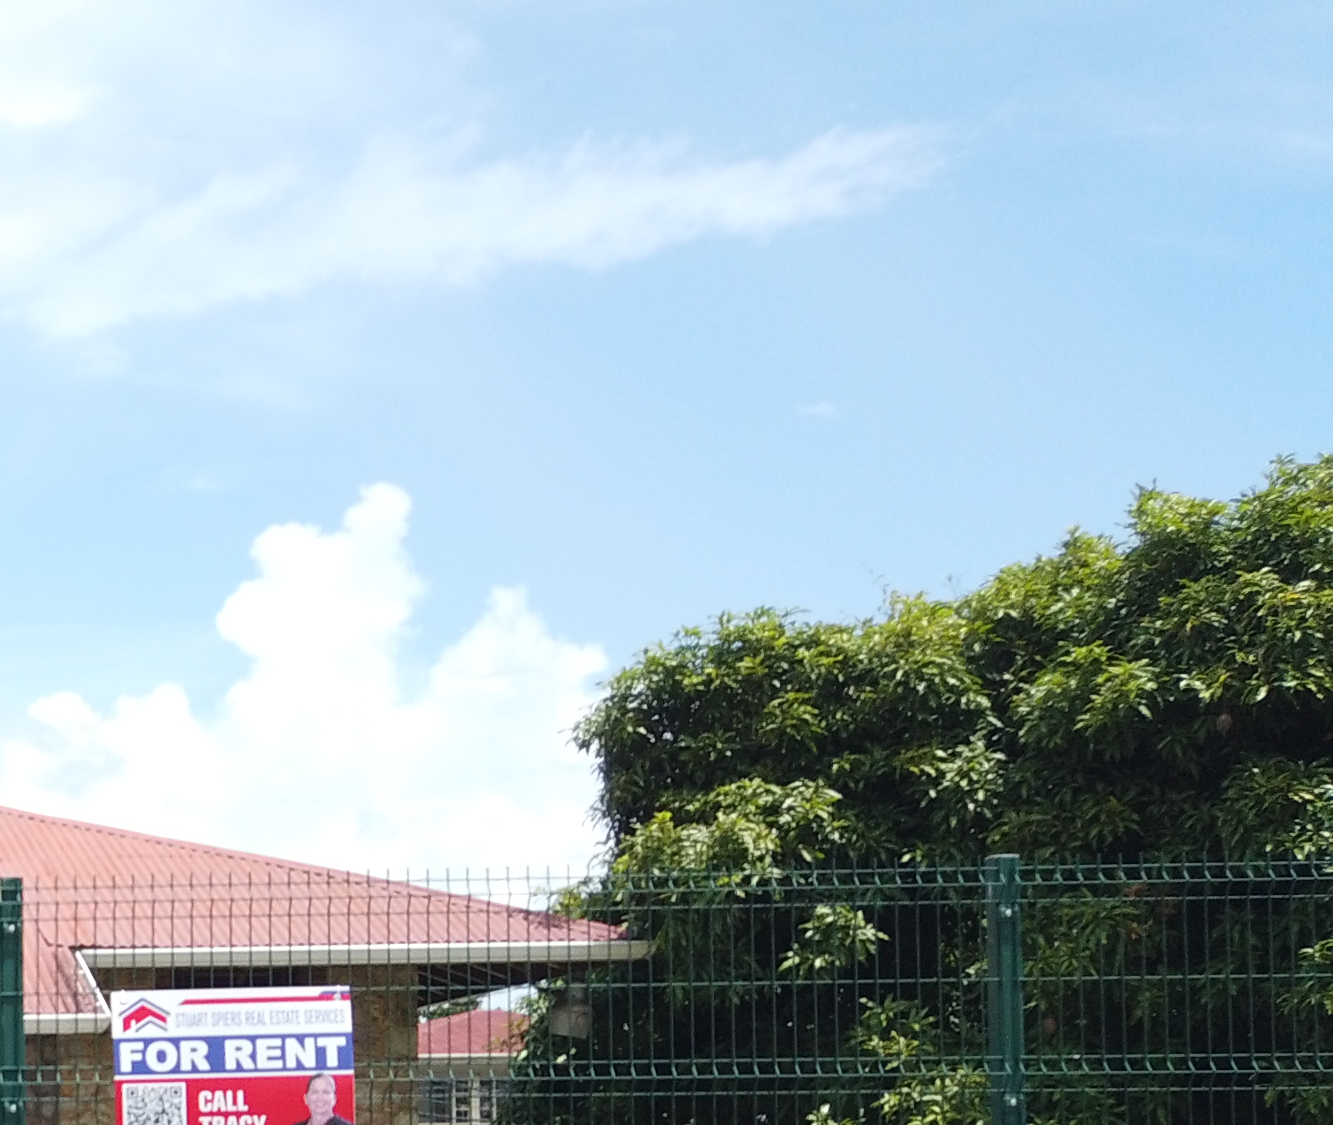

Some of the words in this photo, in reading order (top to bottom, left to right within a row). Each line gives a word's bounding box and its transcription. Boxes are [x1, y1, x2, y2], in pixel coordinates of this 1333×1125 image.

[175, 1012, 208, 1028] STUART
[211, 1010, 242, 1027] SPIERS
[245, 1010, 266, 1026] REAL
[269, 1009, 300, 1025] ESTATE
[303, 1008, 346, 1025] SERVICES
[119, 1040, 211, 1073] FOR
[224, 1036, 347, 1071] RENT
[198, 1089, 249, 1113] CALL
